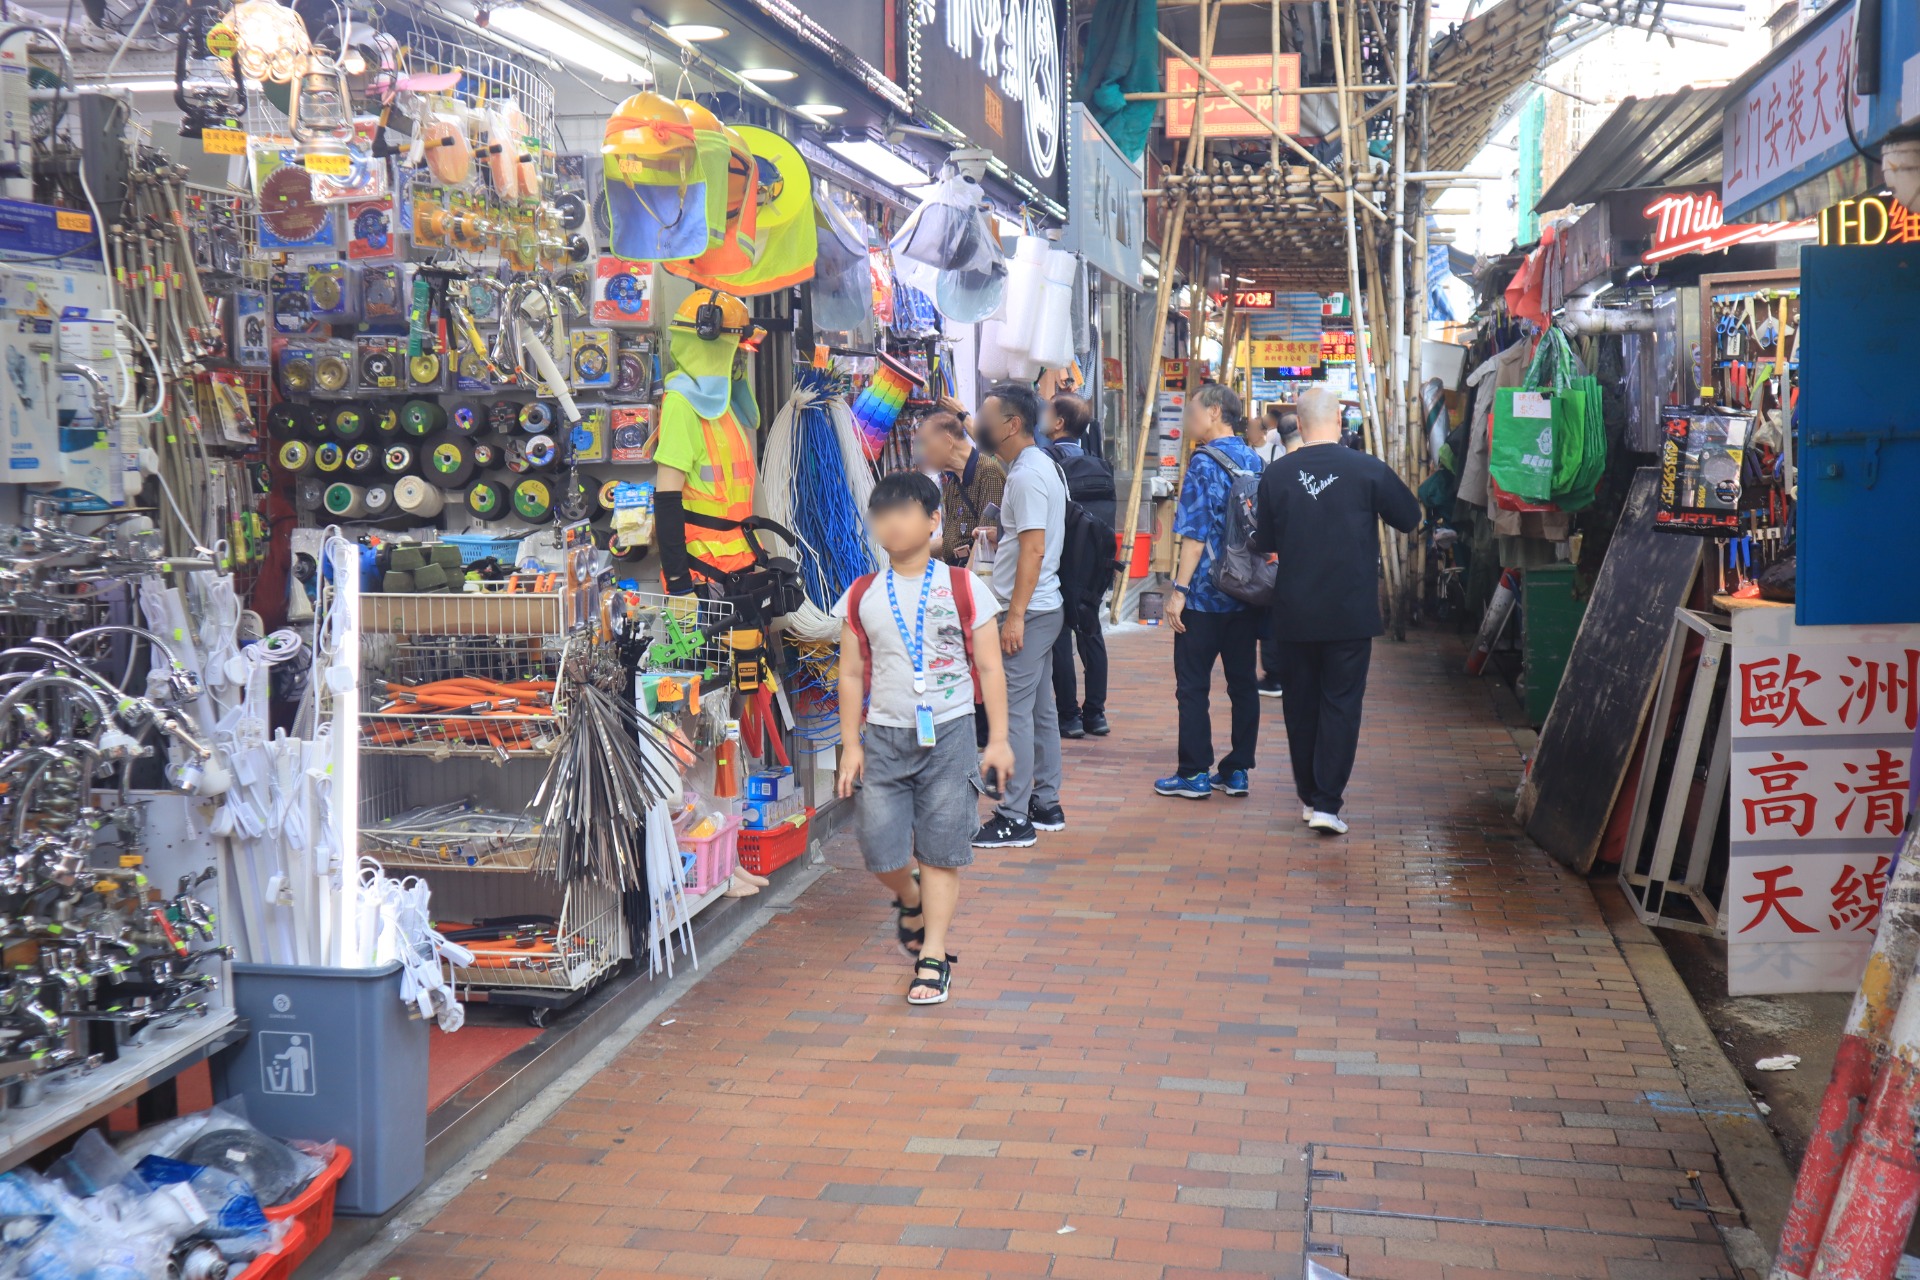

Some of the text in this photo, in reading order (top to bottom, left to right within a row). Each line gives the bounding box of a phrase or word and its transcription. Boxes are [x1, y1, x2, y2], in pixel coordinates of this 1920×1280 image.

[1662, 440, 1679, 505] AIRCRAFT
[1656, 511, 1739, 526] BURTLE
[1739, 648, 1920, 731] 歐洲
[1741, 750, 1911, 837] 高清
[1738, 856, 1893, 936] 天線
